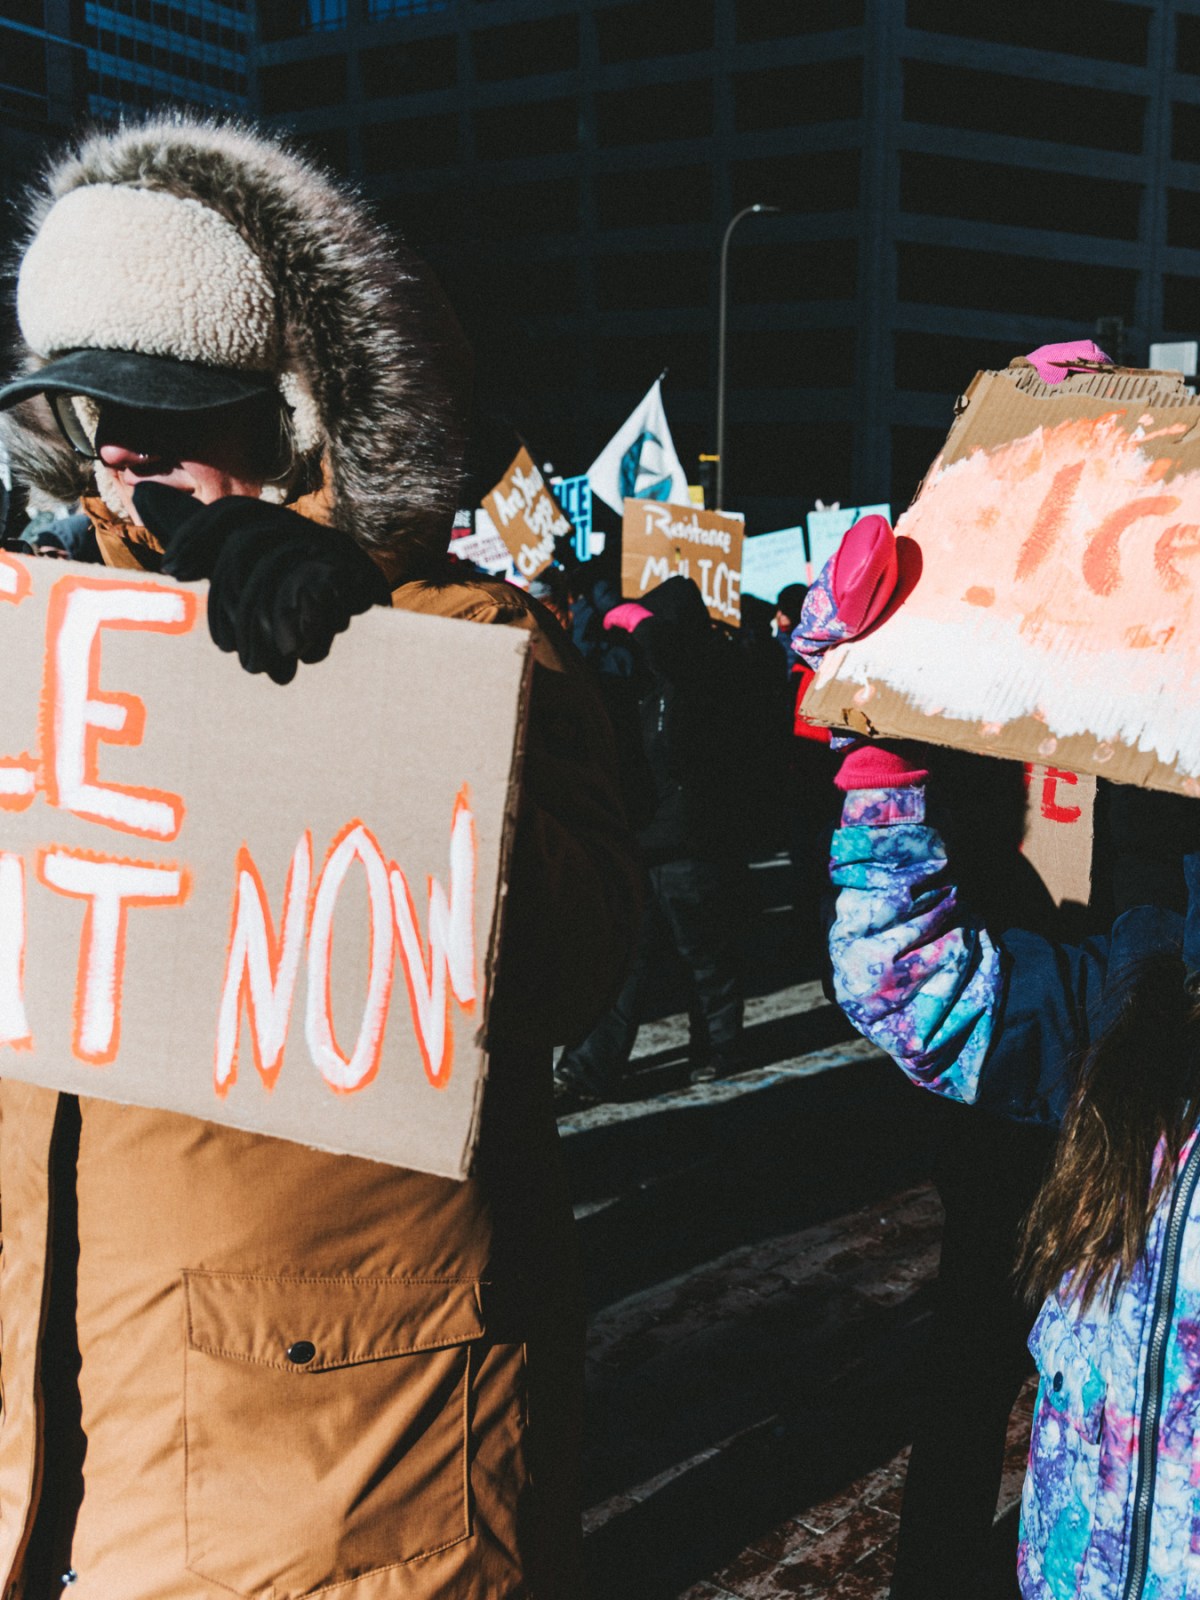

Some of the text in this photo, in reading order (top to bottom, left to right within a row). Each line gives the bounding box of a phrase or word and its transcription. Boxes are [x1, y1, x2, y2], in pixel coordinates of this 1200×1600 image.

[493, 489, 526, 528] Are
[697, 559, 742, 621] ICE
[0, 552, 198, 842] E
[212, 780, 477, 1098] NOW
